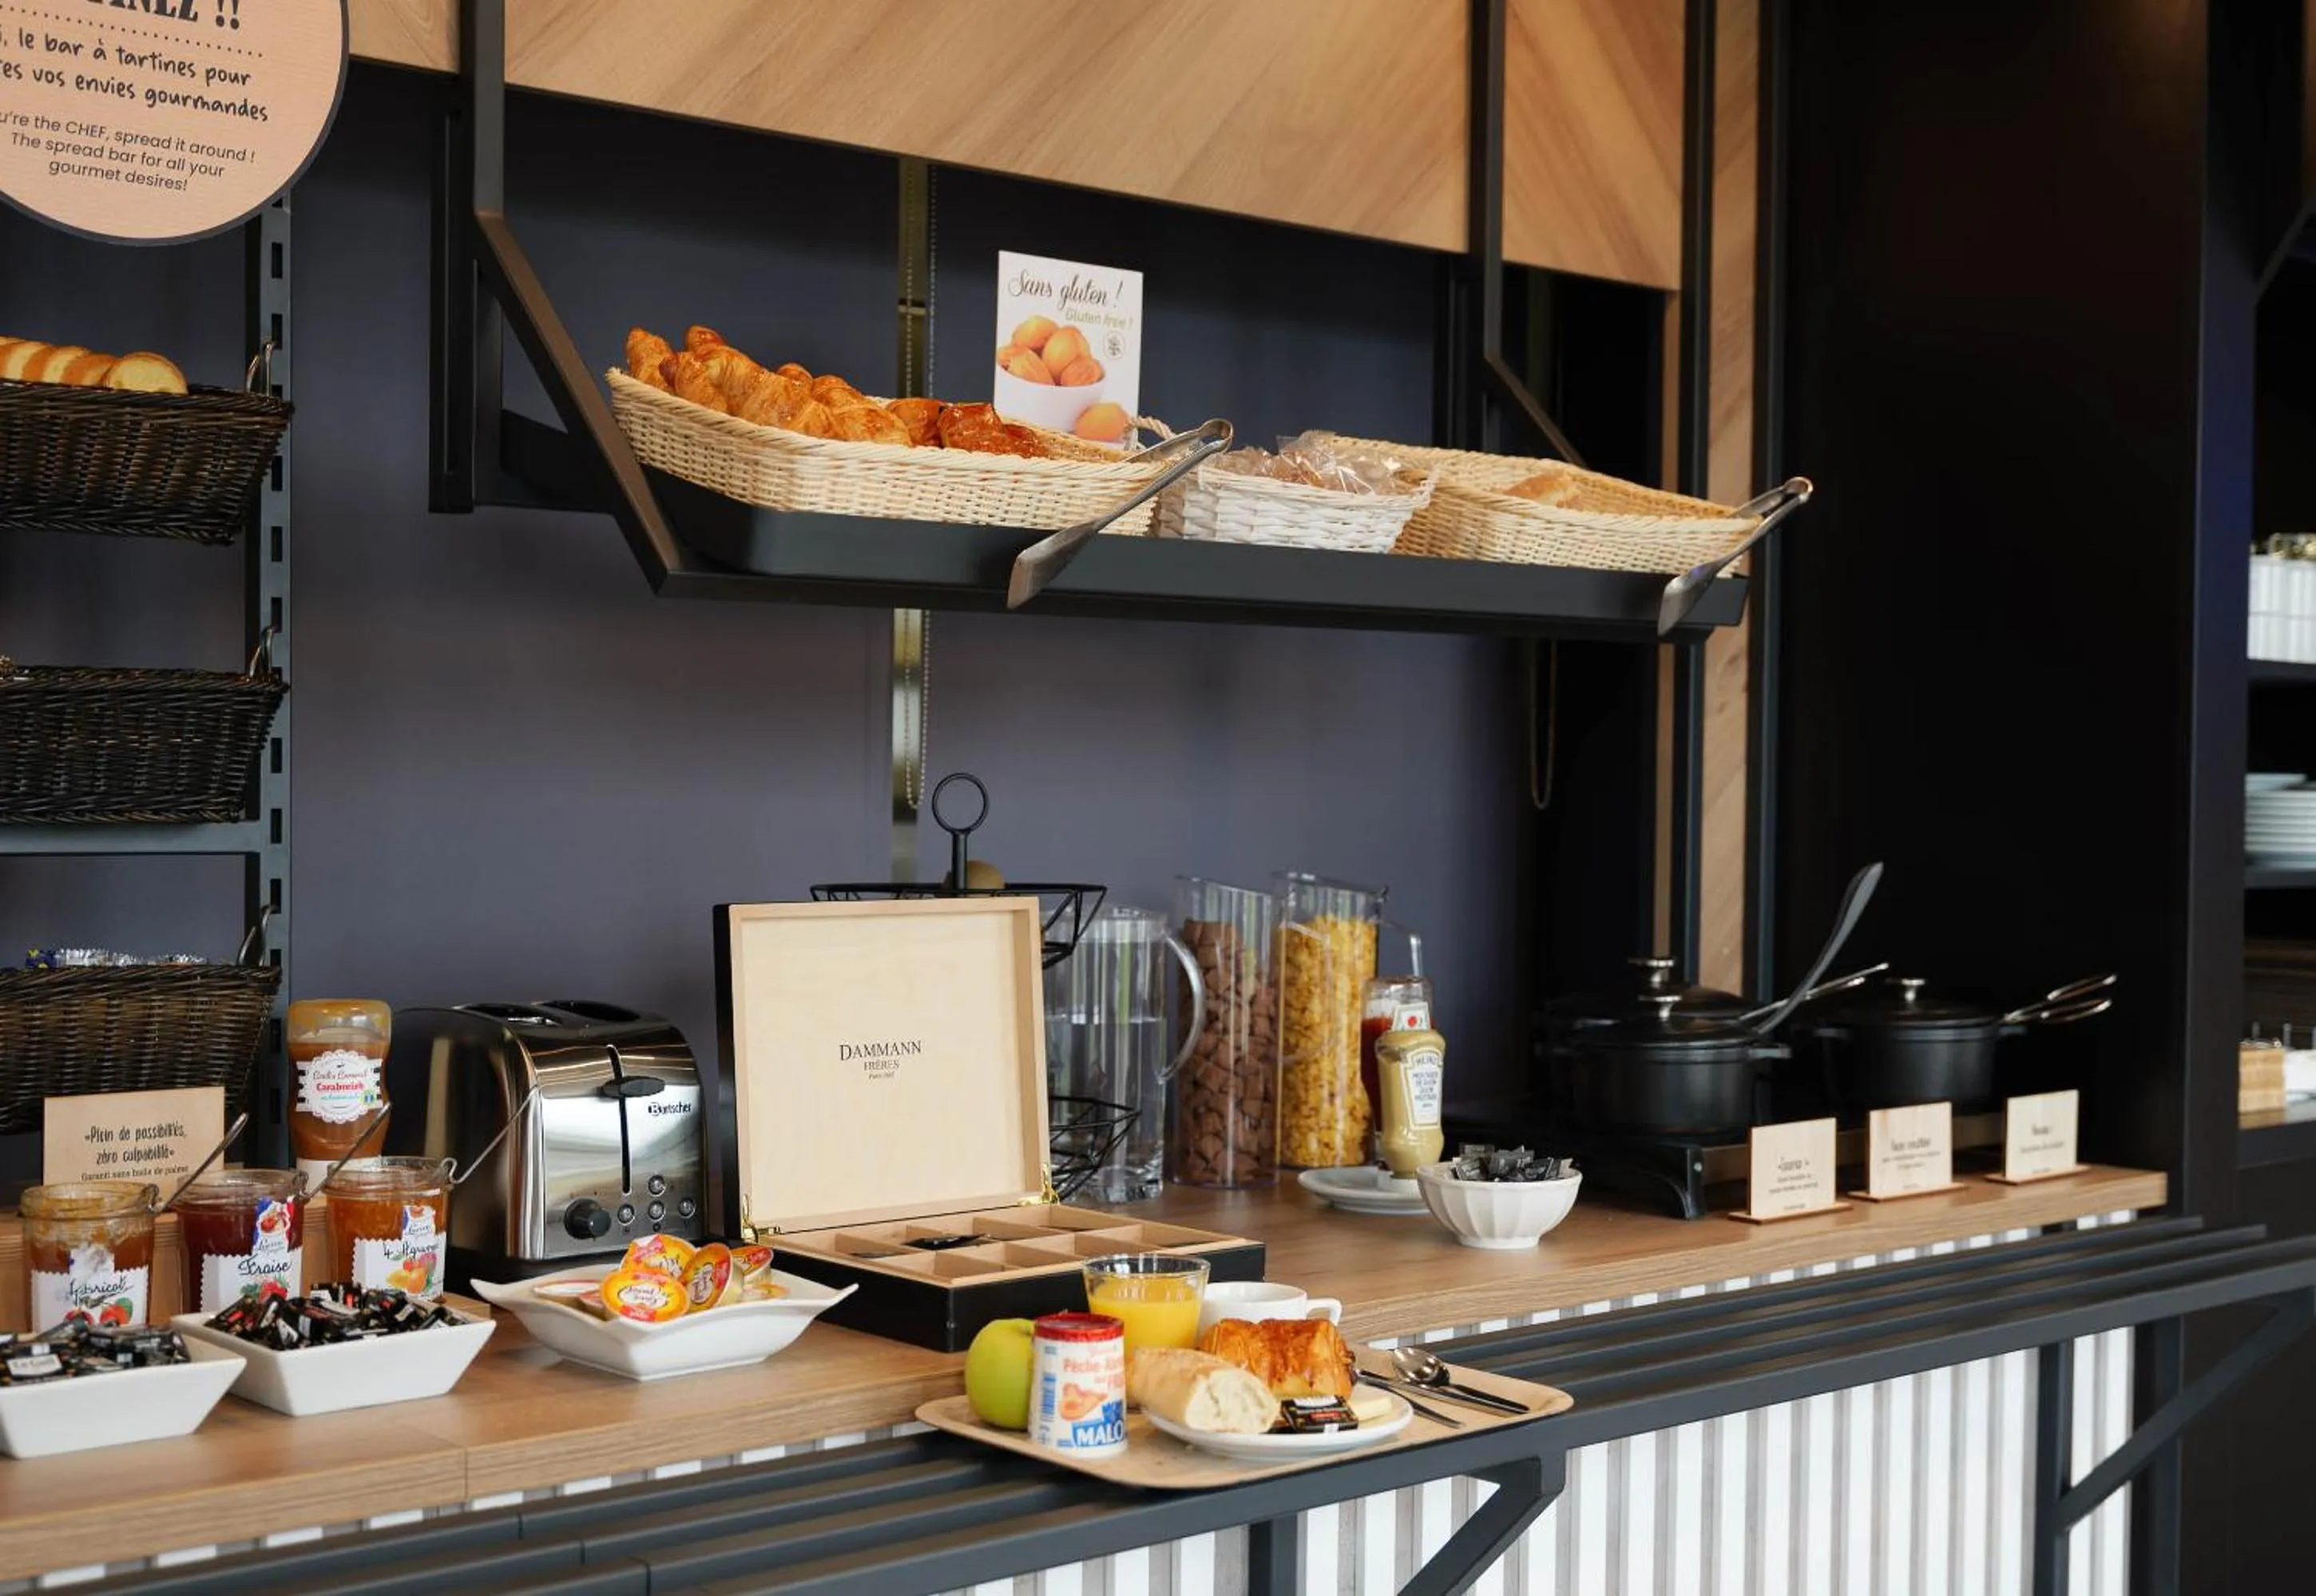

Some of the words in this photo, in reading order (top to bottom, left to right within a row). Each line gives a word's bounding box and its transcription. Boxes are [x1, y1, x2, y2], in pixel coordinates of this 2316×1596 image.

[19, 27, 34, 50] le
[45, 33, 84, 56] bar
[93, 38, 107, 61] à
[116, 46, 196, 78] tartines
[204, 67, 251, 87] pour
[0, 60, 22, 80] es
[33, 69, 65, 87] vos
[75, 74, 136, 99] envies
[145, 89, 268, 121] gourmandes
[34, 115, 61, 132] the
[65, 121, 109, 141] CHEF,
[114, 131, 172, 149] spread
[175, 137, 186, 152] it
[189, 142, 246, 161] around
[250, 150, 256, 163] !
[12, 132, 41, 149] The
[45, 139, 105, 158] spread
[109, 147, 137, 164] bar
[141, 152, 163, 167] for
[166, 157, 185, 170] all
[189, 162, 225, 177] your
[49, 160, 121, 182] gourmet
[125, 169, 188, 191] desires!
[1008, 269, 1052, 297] Sans
[1057, 275, 1108, 311] gluten
[1113, 280, 1124, 308] !
[1065, 308, 1101, 323] Gluten
[839, 1040, 922, 1061] DAMMANN
[119, 1125, 130, 1141] de
[97, 1149, 118, 1165] zéro
[238, 1253, 292, 1276] Fraise
[1077, 1420, 1124, 1446] MALO
